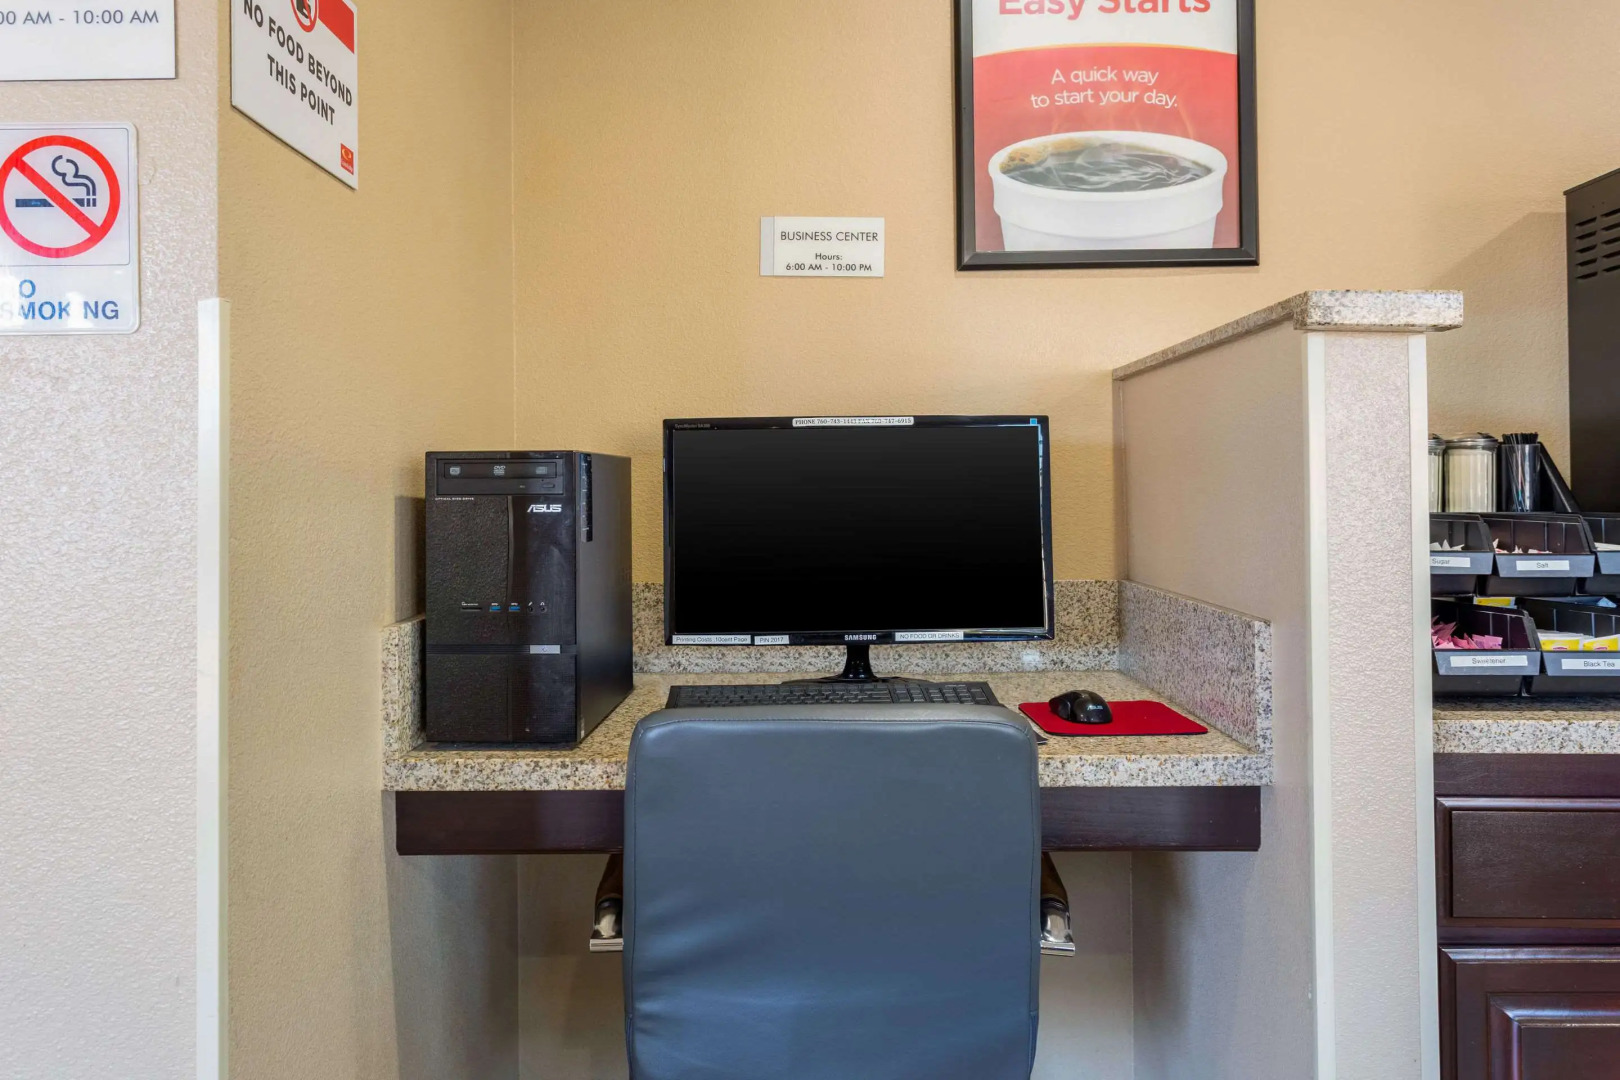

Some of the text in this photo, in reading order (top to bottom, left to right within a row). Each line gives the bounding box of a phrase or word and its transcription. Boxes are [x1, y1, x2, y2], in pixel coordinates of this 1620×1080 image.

[23, 11, 52, 25] AM
[73, 10, 124, 24] 10:00
[130, 10, 159, 24] AM
[999, 0, 1085, 20] Easy
[243, 0, 352, 107] NO FOOD BEYOND
[1051, 66, 1159, 86] A quick way
[267, 53, 335, 125] THIS POINT
[1031, 89, 1178, 109] to start your day.
[780, 231, 879, 241] BUSINESS CENTER
[815, 252, 843, 261] Hours:
[785, 263, 806, 271] 6:00
[832, 263, 857, 271] 10:00
[859, 263, 872, 271] PM
[527, 504, 562, 513] ASUS
[1431, 557, 1450, 567] Sugar
